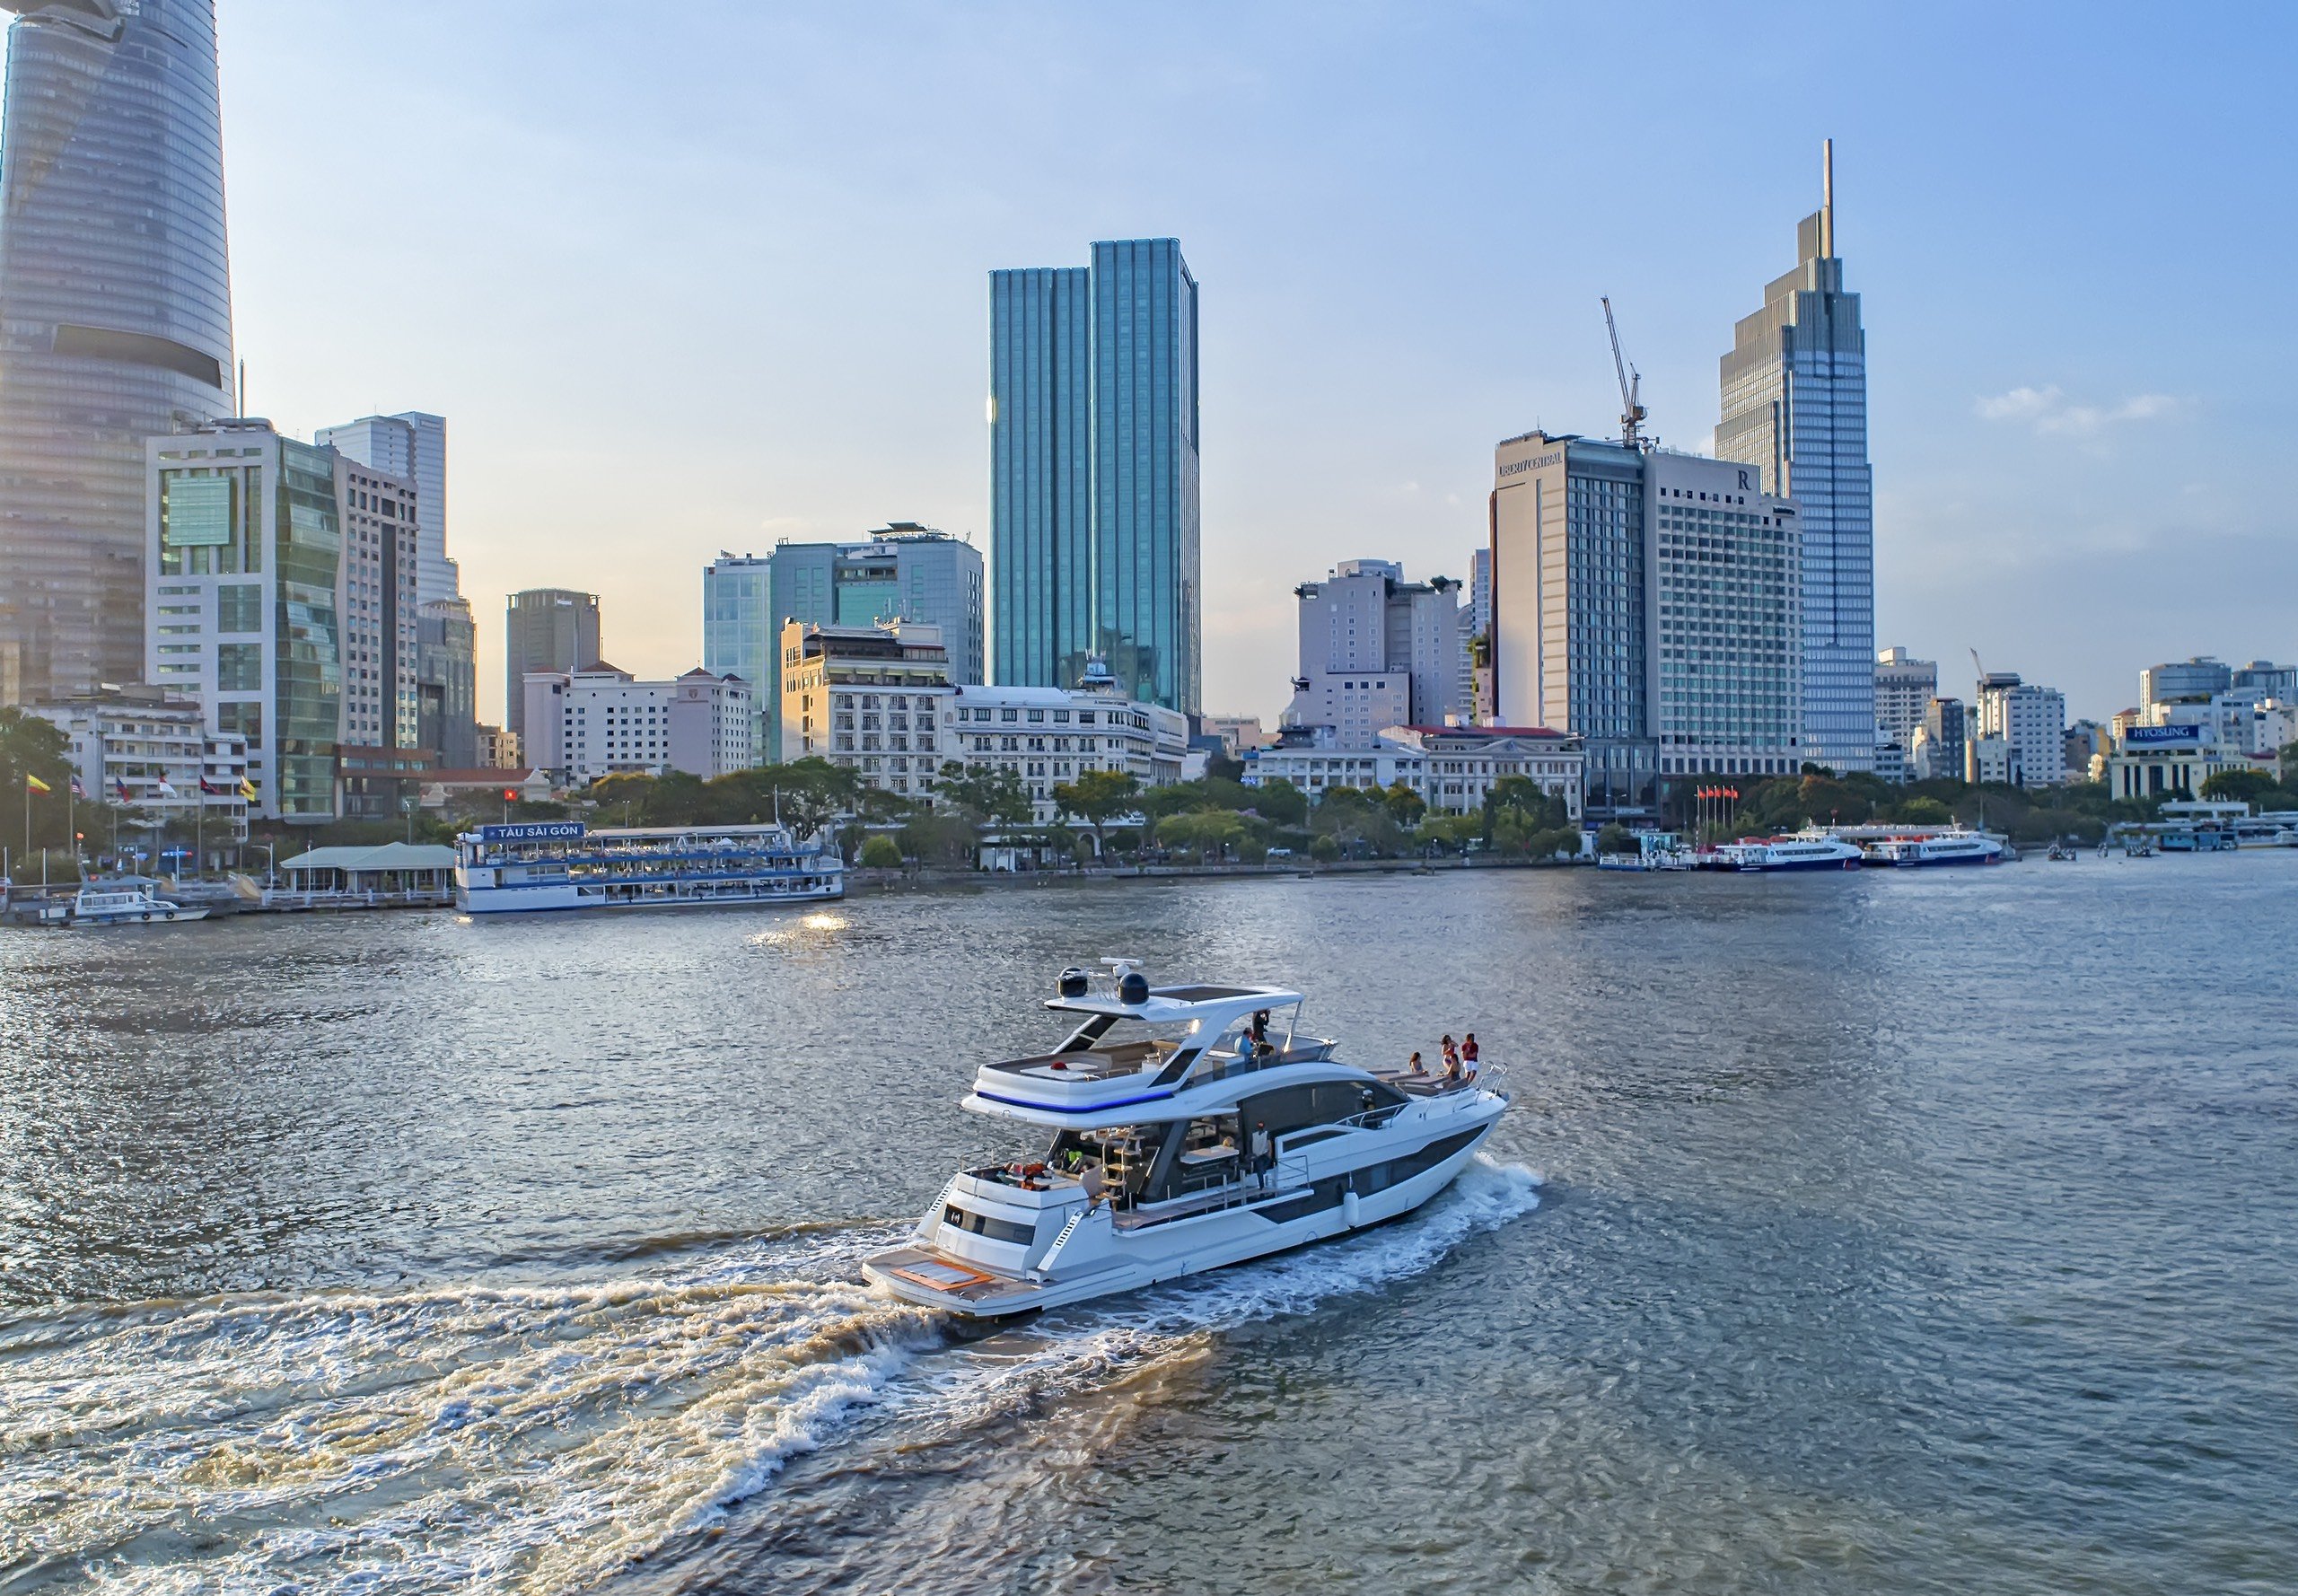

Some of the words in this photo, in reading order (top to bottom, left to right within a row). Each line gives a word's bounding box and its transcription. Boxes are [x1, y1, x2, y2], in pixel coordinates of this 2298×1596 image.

[1500, 460, 1528, 477] LIBERTY
[1529, 452, 1562, 470] CENTRAL
[1738, 469, 1751, 491] R
[2135, 726, 2189, 738] HYOSUNG
[498, 827, 523, 837] TÀU
[527, 826, 547, 837] SÀI
[550, 825, 578, 836] GÒN
